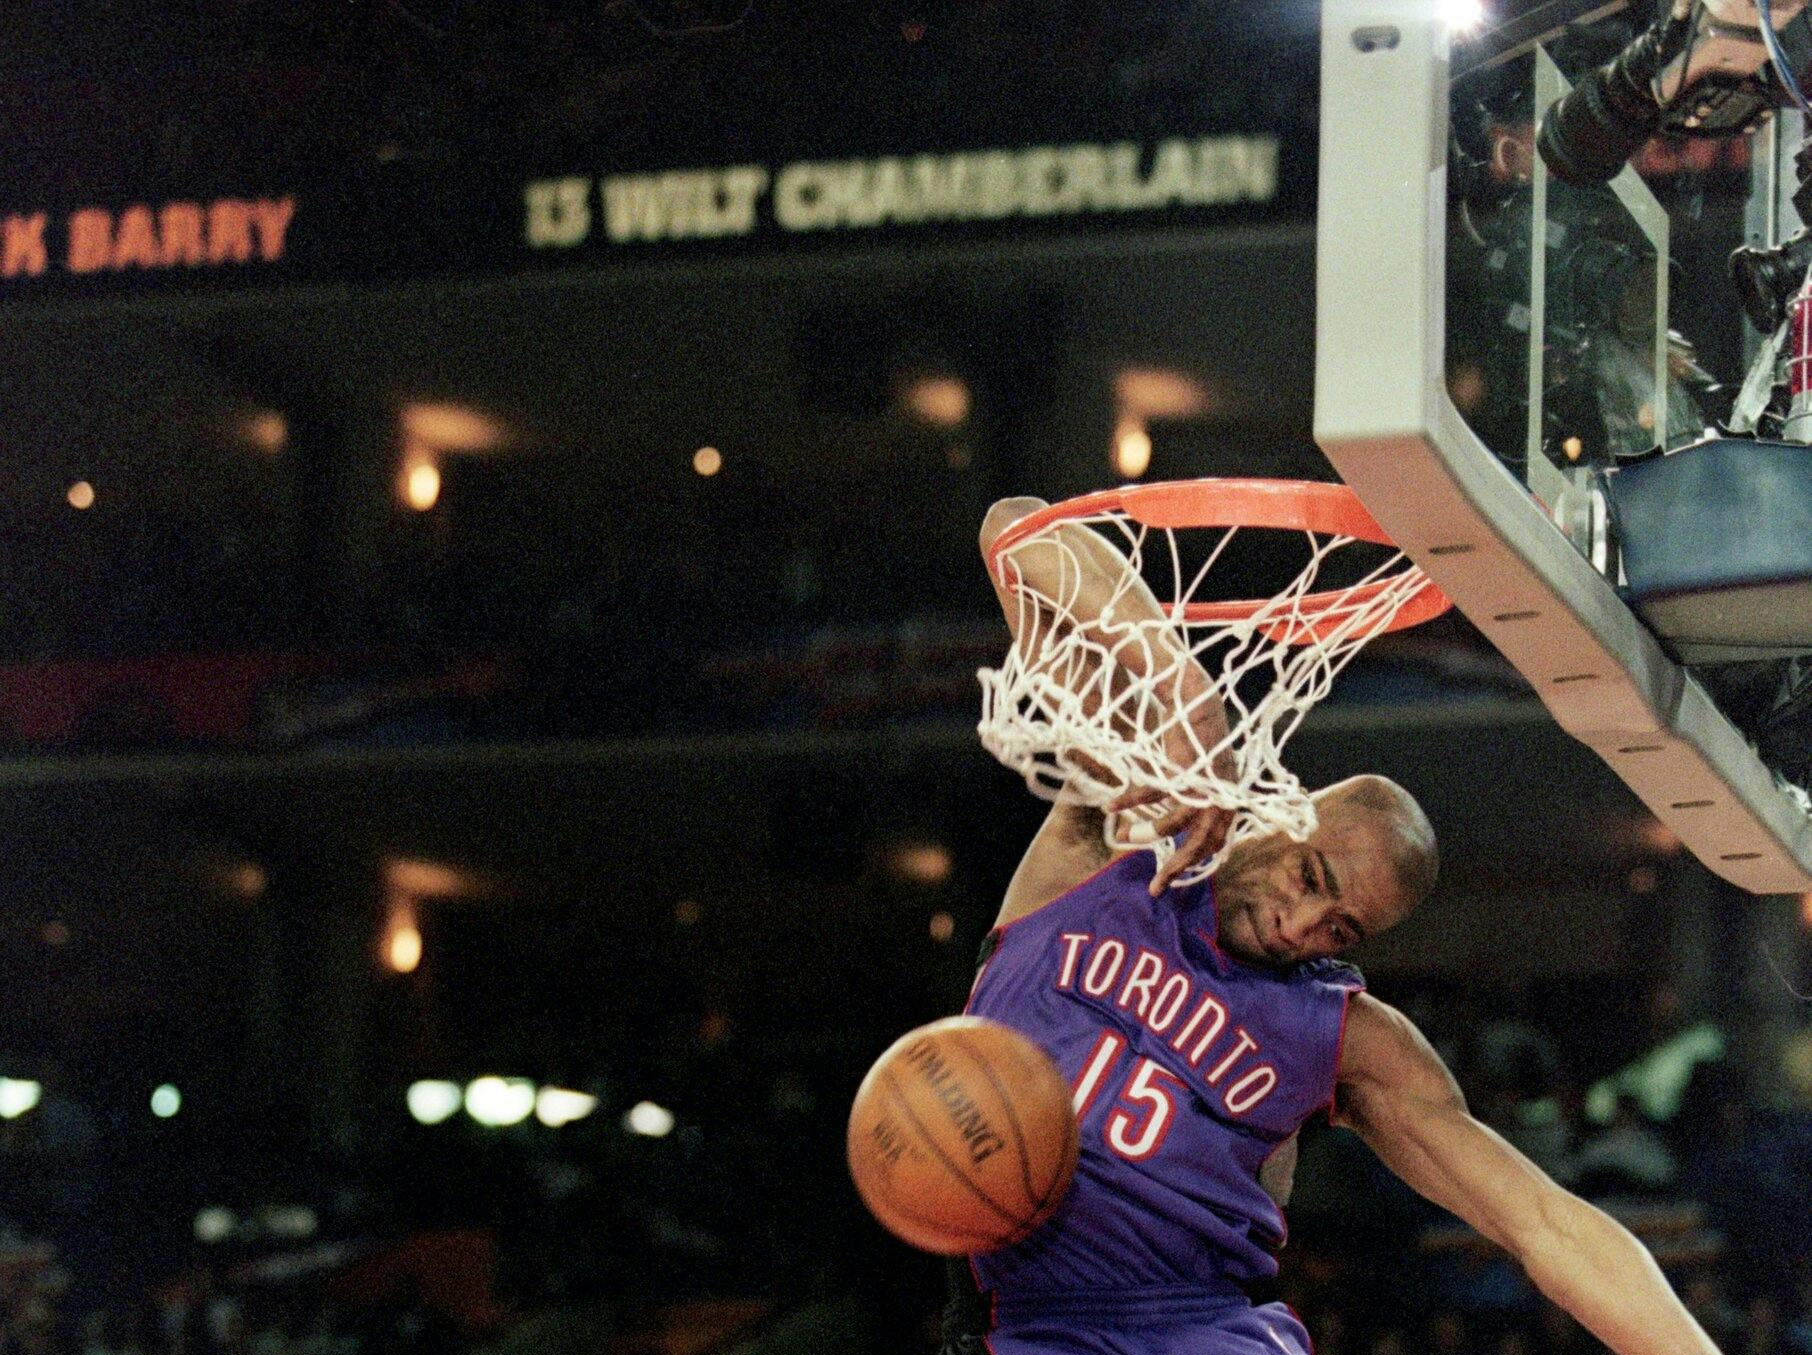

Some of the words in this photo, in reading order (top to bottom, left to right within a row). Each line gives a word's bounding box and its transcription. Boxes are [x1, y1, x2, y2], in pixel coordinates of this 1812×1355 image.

[68, 198, 296, 273] BARRY
[604, 166, 767, 242] WILT
[774, 135, 1279, 231] CHAMBERLAIN
[1059, 931, 1279, 1116] TORONTO
[1073, 1029, 1190, 1162] 15
